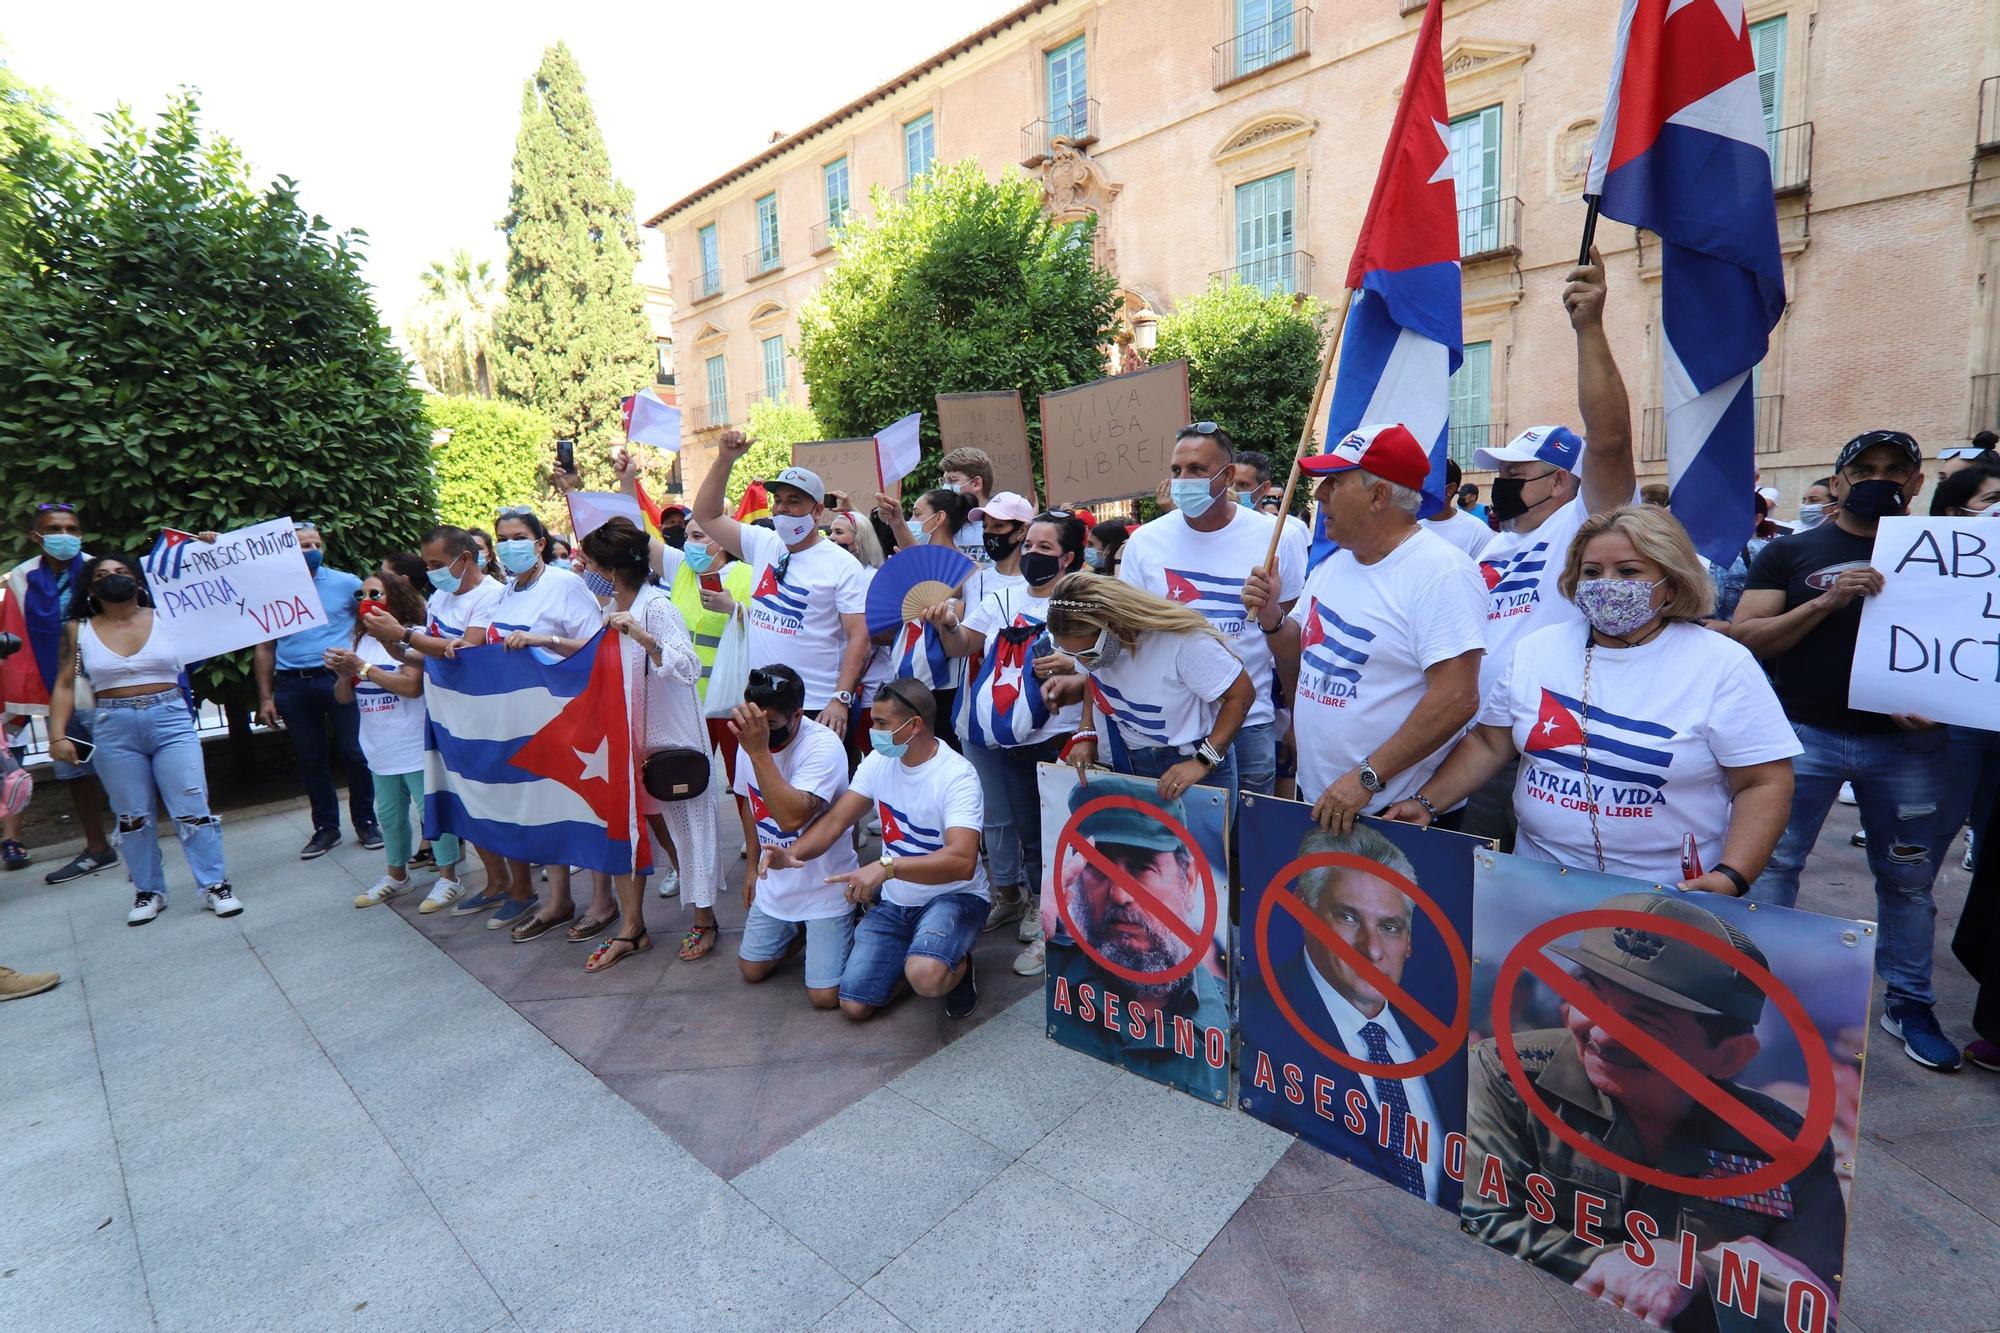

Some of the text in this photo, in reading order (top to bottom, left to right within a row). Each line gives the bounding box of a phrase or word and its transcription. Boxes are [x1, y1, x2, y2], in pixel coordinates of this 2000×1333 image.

[1072, 414, 1143, 447] CUBA
[191, 543, 247, 575] PRESOS
[162, 576, 238, 618] PATRIA
[1496, 590, 1540, 610] Y VIDA
[248, 595, 314, 634] VIDA
[781, 617, 804, 630] VIDA
[1503, 605, 1531, 617] LIBRE
[777, 627, 798, 636] LIBRE
[1219, 621, 1246, 633] VIDA
[1313, 676, 1320, 690] Y
[1323, 680, 1358, 699] VIDA
[1317, 695, 1346, 708] LIBRE
[1527, 785, 1653, 818] VIVA CUBA LIBRE
[1592, 784, 1604, 801] Y
[1612, 788, 1667, 805] VIDA
[1054, 976, 1225, 1069] ASESINO
[1254, 1050, 1468, 1182] ASESINO
[1478, 1153, 1829, 1333] ASESINO
